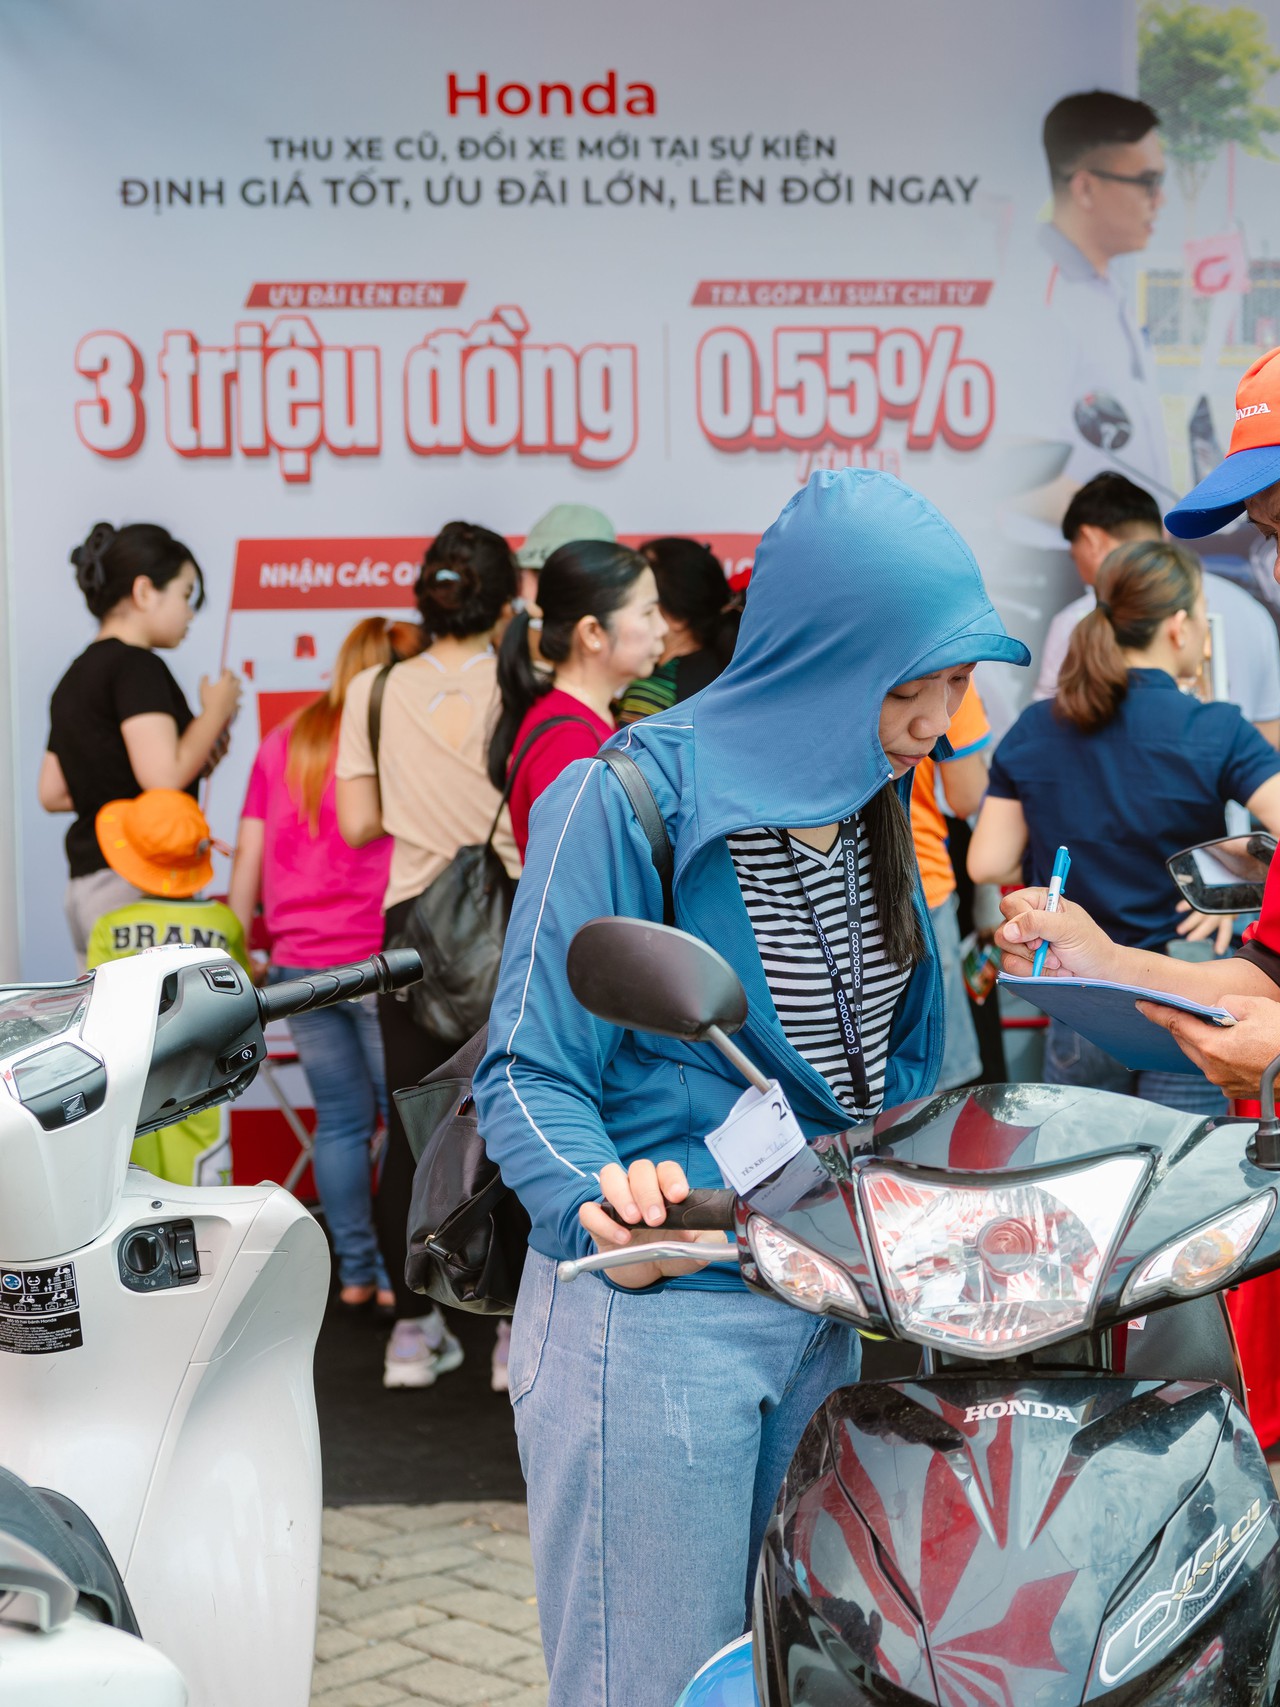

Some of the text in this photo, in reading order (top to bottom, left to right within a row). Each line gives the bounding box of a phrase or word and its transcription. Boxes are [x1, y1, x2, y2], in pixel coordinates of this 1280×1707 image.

[446, 70, 657, 117] Honda
[268, 129, 835, 167] THU XE CŨ, ĐỔI XE MỚI TẠI SỰ KIỆN
[119, 167, 979, 216] ĐỊNH GIÁ TỐT, ƯU ĐÃI LỚN, LÊN ĐỜI NGAY
[268, 284, 305, 307] ƯU
[351, 282, 394, 307] LÊN
[74, 305, 638, 484] 3 triệu đồng
[695, 325, 996, 452] 0.55%
[1236, 402, 1271, 420] NDA
[259, 557, 335, 593] NHẬN
[336, 556, 391, 588] CÁC
[963, 1400, 1078, 1424] HONDA
